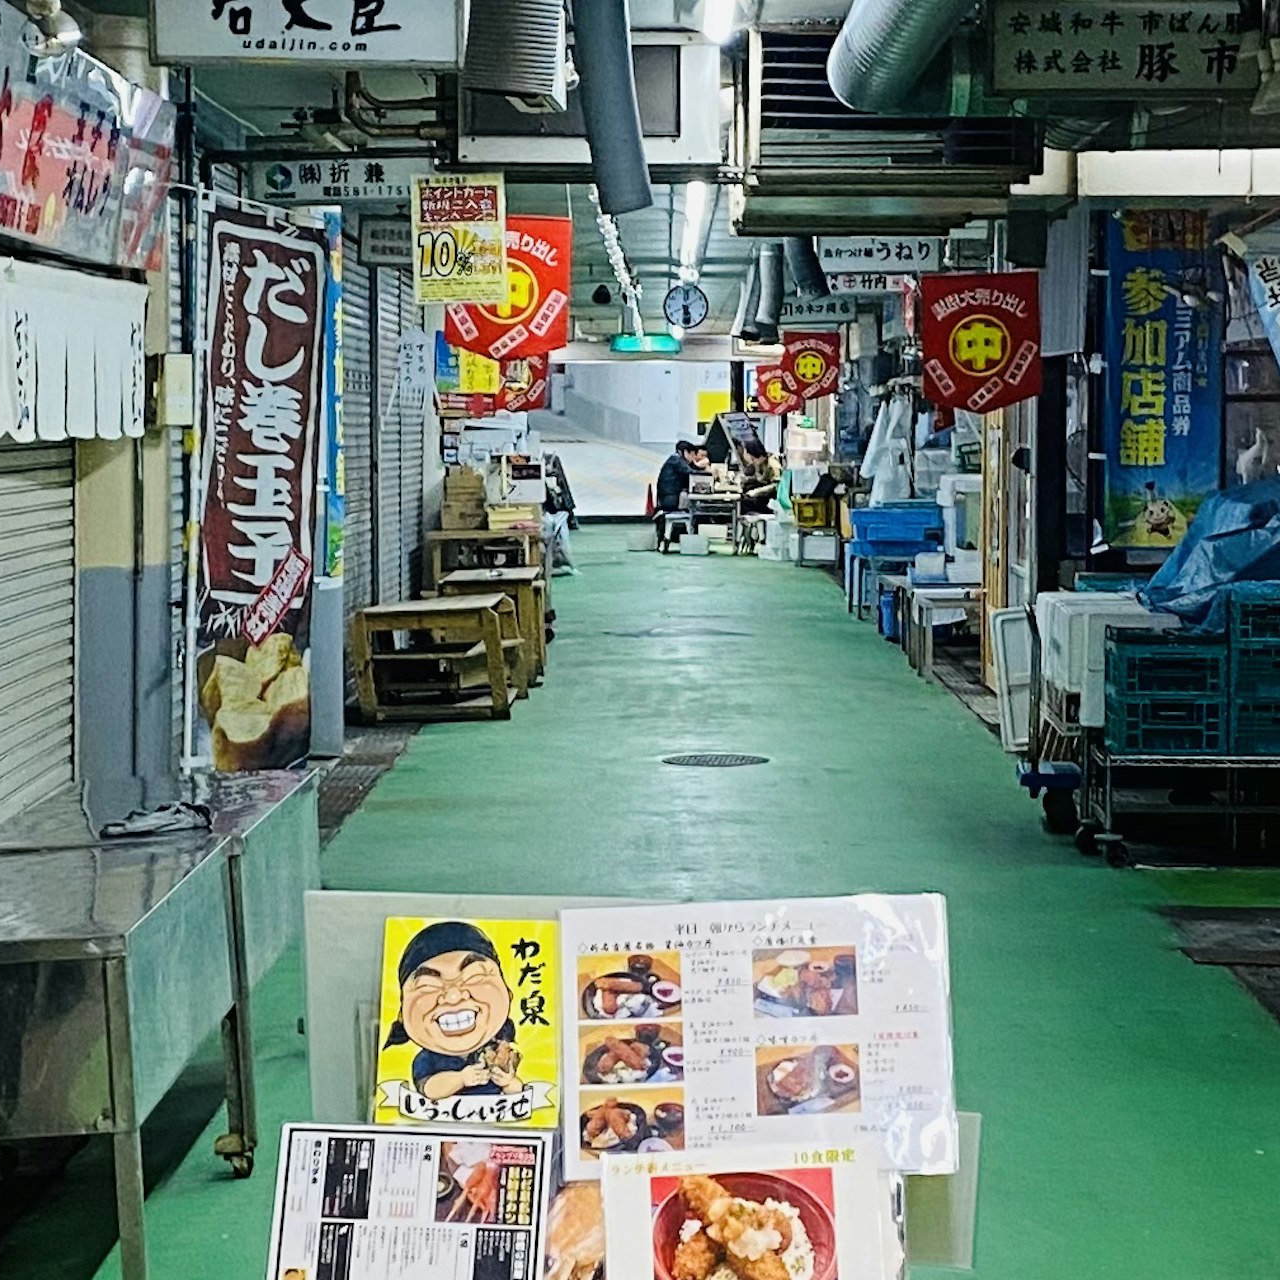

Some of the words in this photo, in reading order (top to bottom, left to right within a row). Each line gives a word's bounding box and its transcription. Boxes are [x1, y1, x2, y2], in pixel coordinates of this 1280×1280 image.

[241, 37, 368, 54] udaijin.com
[1013, 48, 1124, 74] 株式会社
[1134, 39, 1242, 84] 豚市
[876, 240, 932, 262] うねり
[1120, 265, 1168, 467] 参加店舗
[226, 248, 310, 586] だし巻玉子
[510, 936, 551, 1027] わだ泉
[792, 1148, 856, 1165] 10食限定
